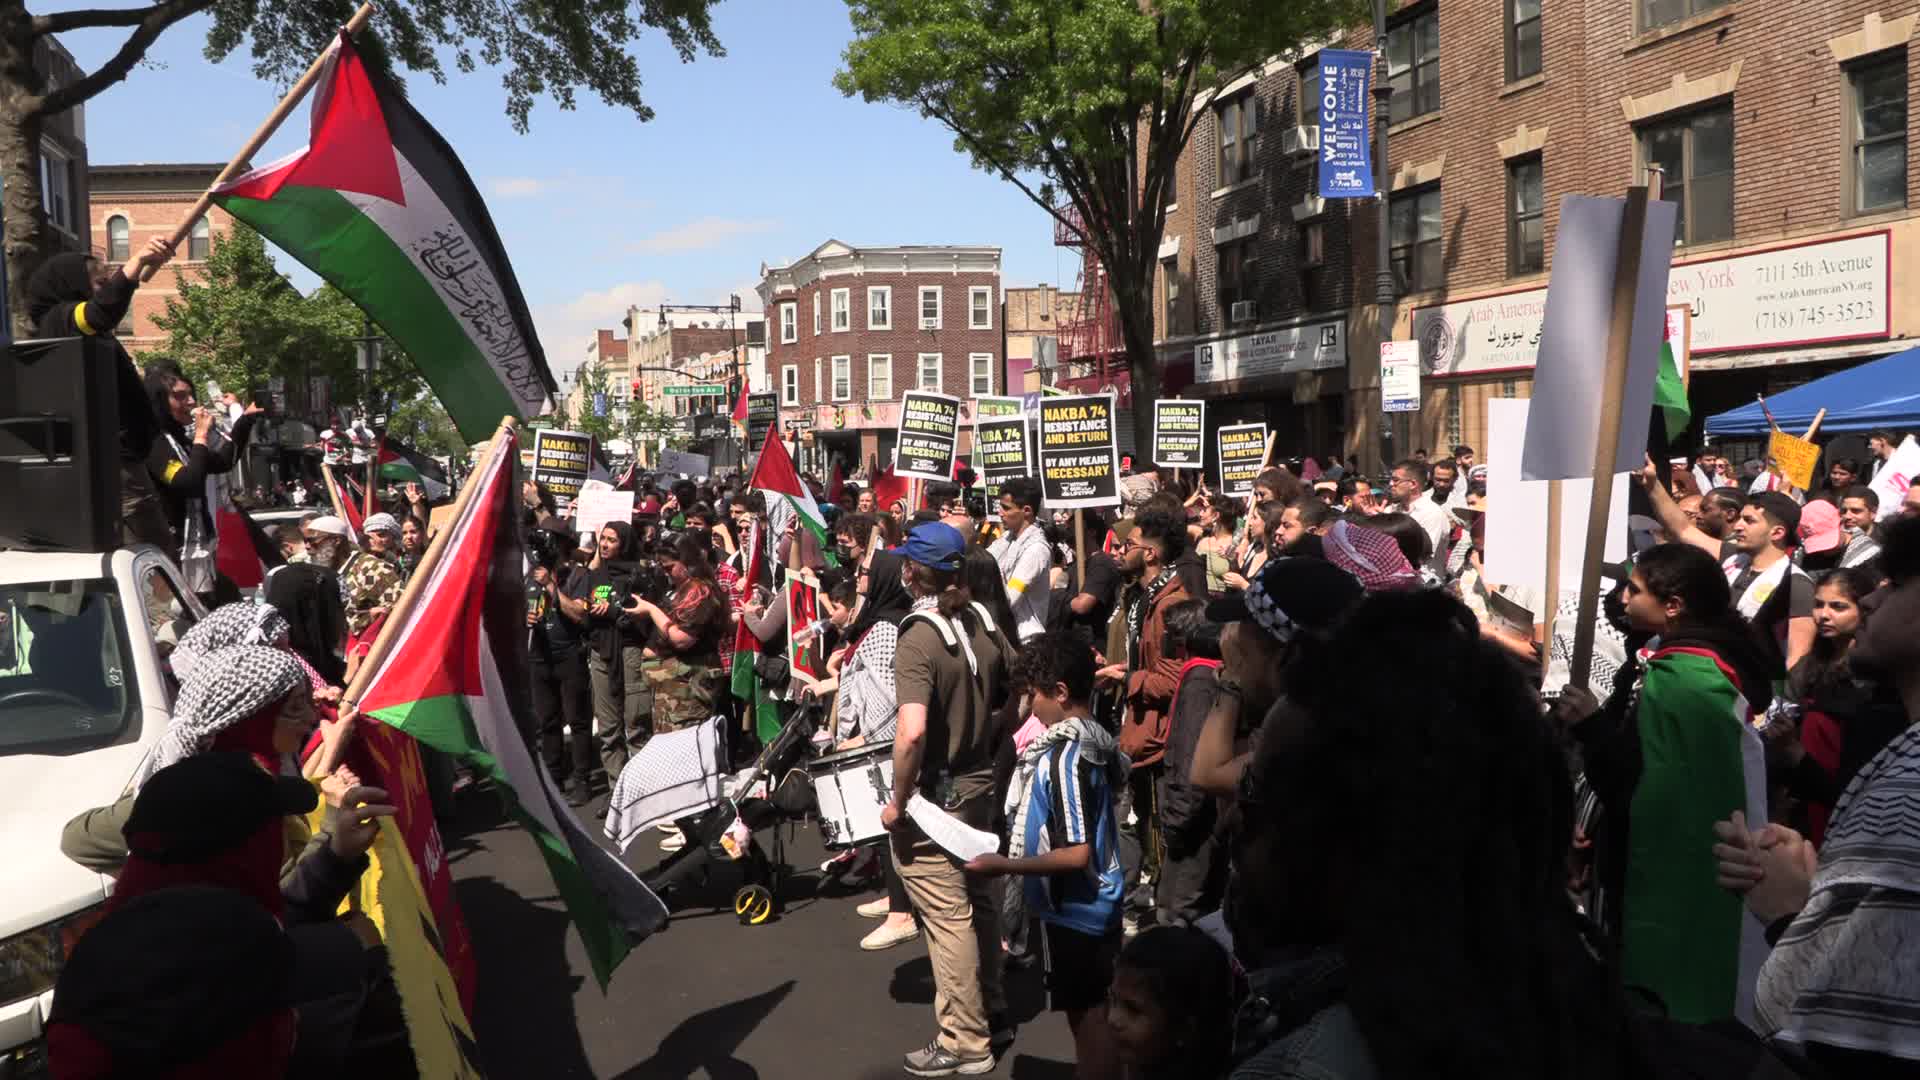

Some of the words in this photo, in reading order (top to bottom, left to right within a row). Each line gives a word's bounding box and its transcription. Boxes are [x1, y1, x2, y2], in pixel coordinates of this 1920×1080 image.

[1324, 66, 1337, 162] WELCOME
[1757, 263, 1786, 284] 7111
[1792, 260, 1814, 281] 5th
[1817, 255, 1874, 276] Avenue
[1471, 304, 1494, 322] Arab
[1667, 278, 1689, 295] ew
[1697, 264, 1736, 291] York
[1755, 310, 1794, 330] (718)
[1799, 301, 1875, 326] 745-3523
[1251, 335, 1277, 346] TAYAR
[907, 400, 942, 413] NAKBA
[944, 405, 955, 416] 74
[1044, 407, 1087, 421] NAKBA
[1090, 404, 1107, 418] 74
[1159, 407, 1187, 416] NAKBA
[1188, 407, 1200, 416] 74
[906, 411, 954, 425] RESISTANCE
[905, 419, 922, 429] AND
[923, 421, 953, 433] RETURN
[1044, 419, 1107, 433] RESISTANCE
[1004, 428, 1020, 440] 74
[1045, 433, 1065, 444] AND
[1067, 431, 1108, 443] RETURN
[1221, 433, 1250, 442] NAKBA
[1251, 432, 1262, 440] 74
[541, 438, 577, 451] NAKBA
[902, 438, 911, 447] BY
[913, 439, 929, 448] ANY
[929, 441, 951, 451] MEANS
[540, 449, 587, 462] RESISTANCE
[901, 446, 950, 461] NECESSARY
[1223, 450, 1236, 458] AND
[540, 458, 558, 467] AND
[559, 459, 587, 469] RETURN
[1045, 458, 1057, 467] BY
[1058, 457, 1077, 467] ANY
[1079, 455, 1109, 466] MEANS
[1046, 465, 1109, 479] NECESSARY
